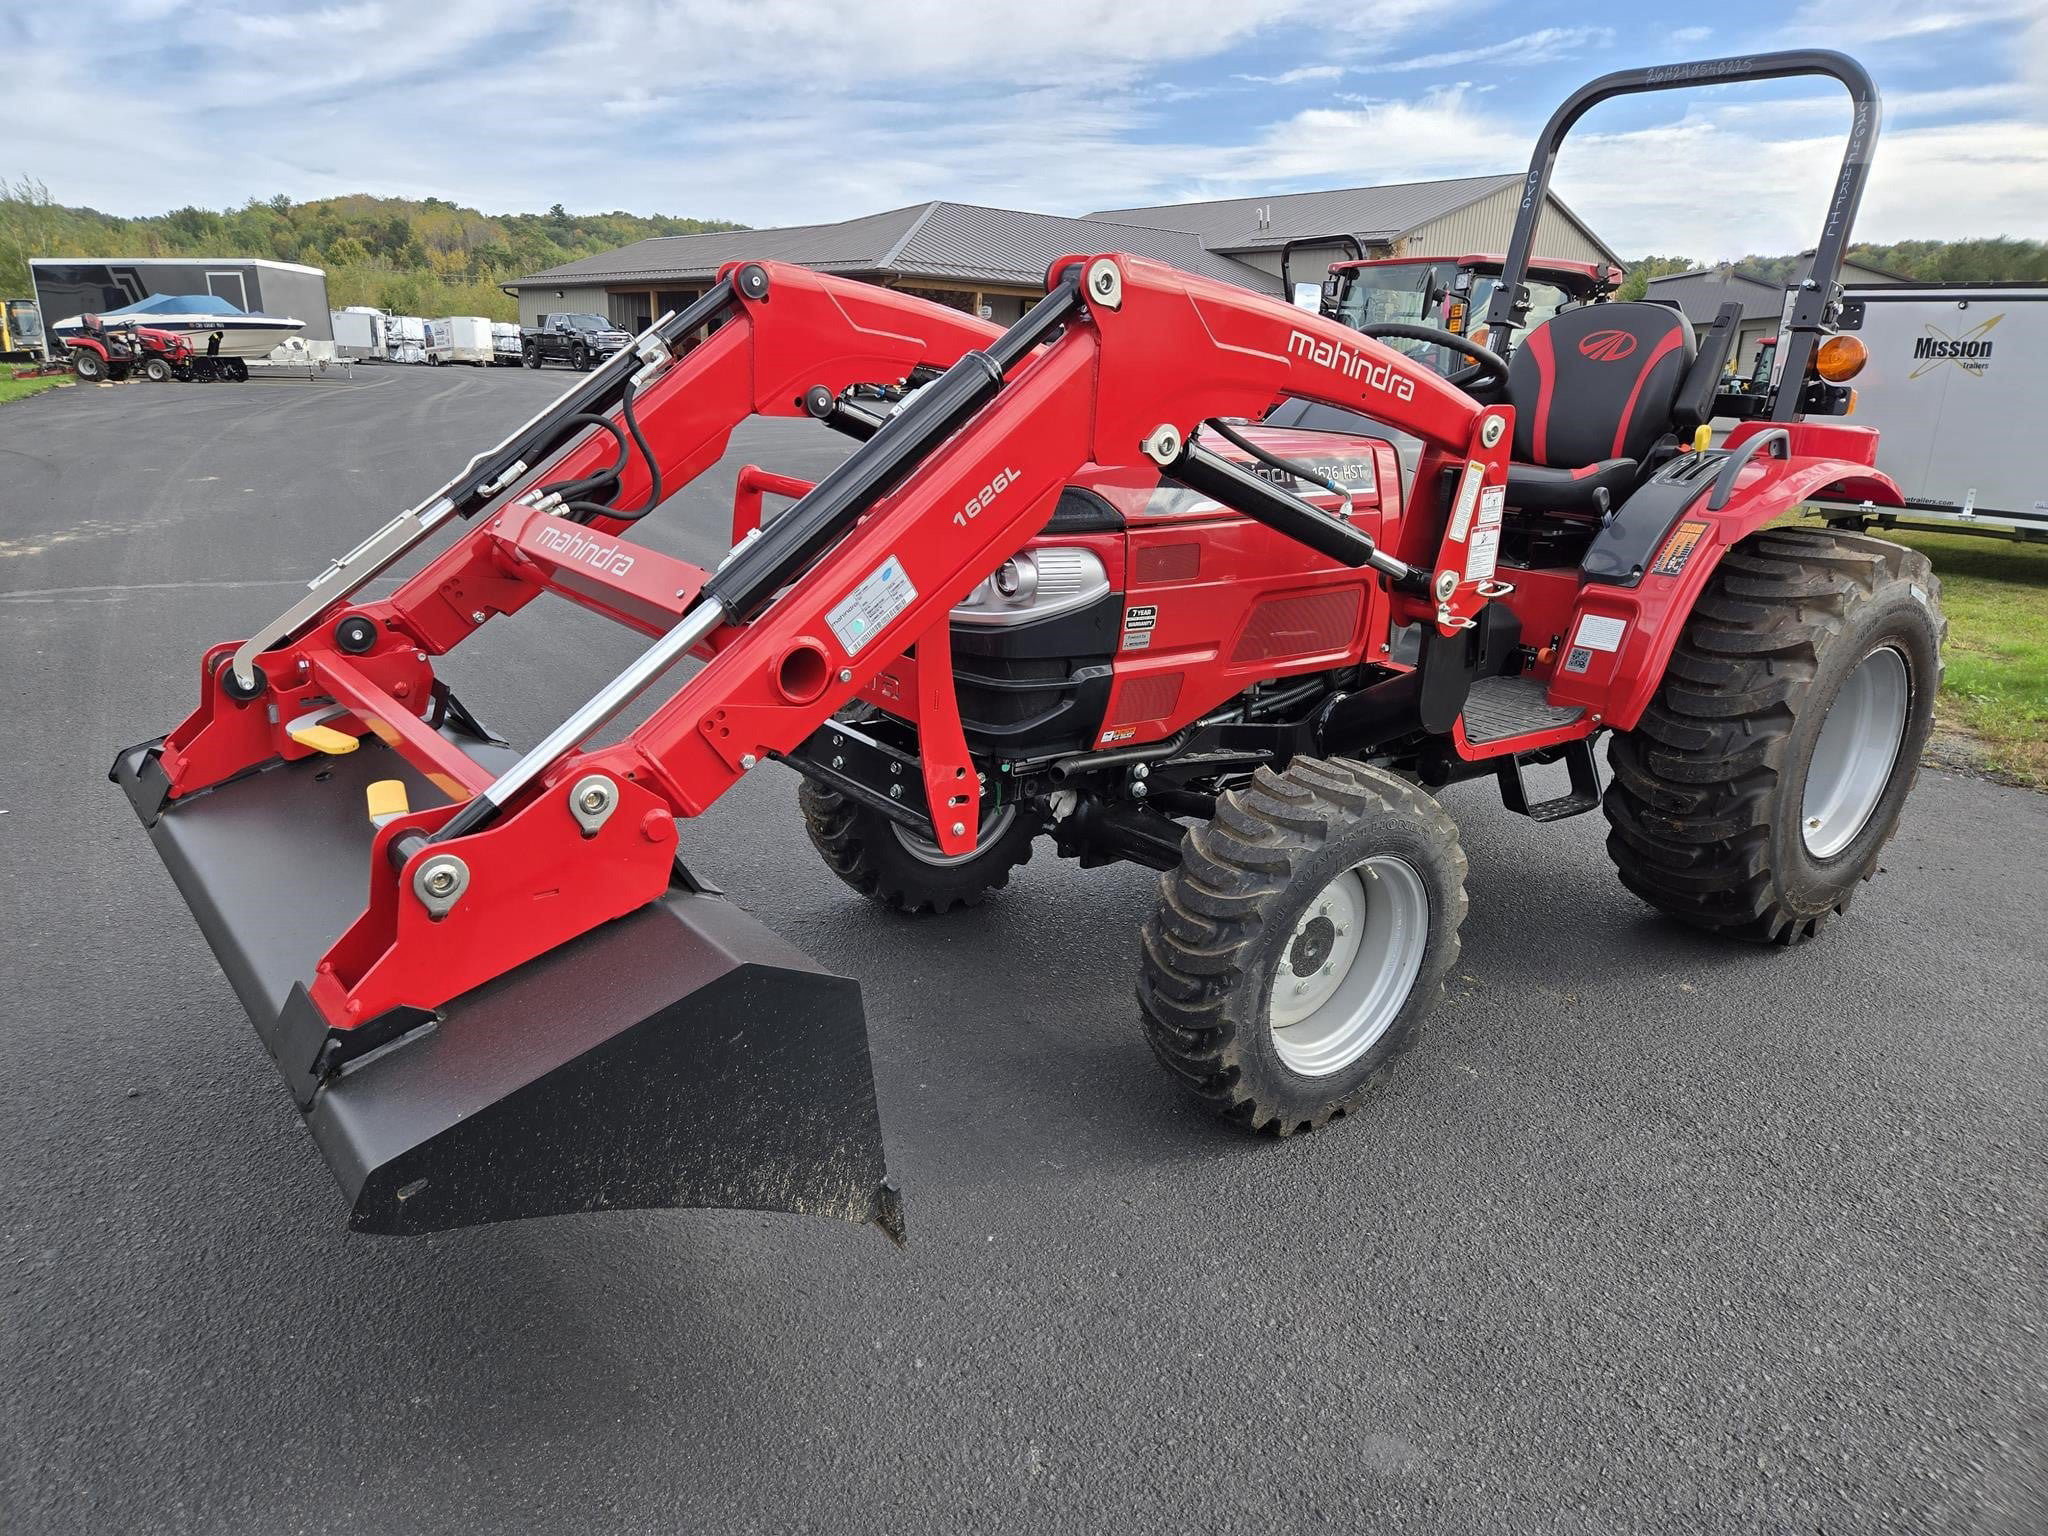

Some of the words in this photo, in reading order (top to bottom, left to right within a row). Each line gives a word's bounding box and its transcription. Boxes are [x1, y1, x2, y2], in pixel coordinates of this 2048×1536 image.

[1913, 338, 1993, 359] Mission
[1287, 330, 1415, 402] mahindra
[1961, 362, 1989, 370] Trailers
[1342, 464, 1363, 480] HST
[953, 467, 1021, 527] 1626L
[535, 526, 635, 577] mahindra
[1132, 609, 1138, 617] 7
